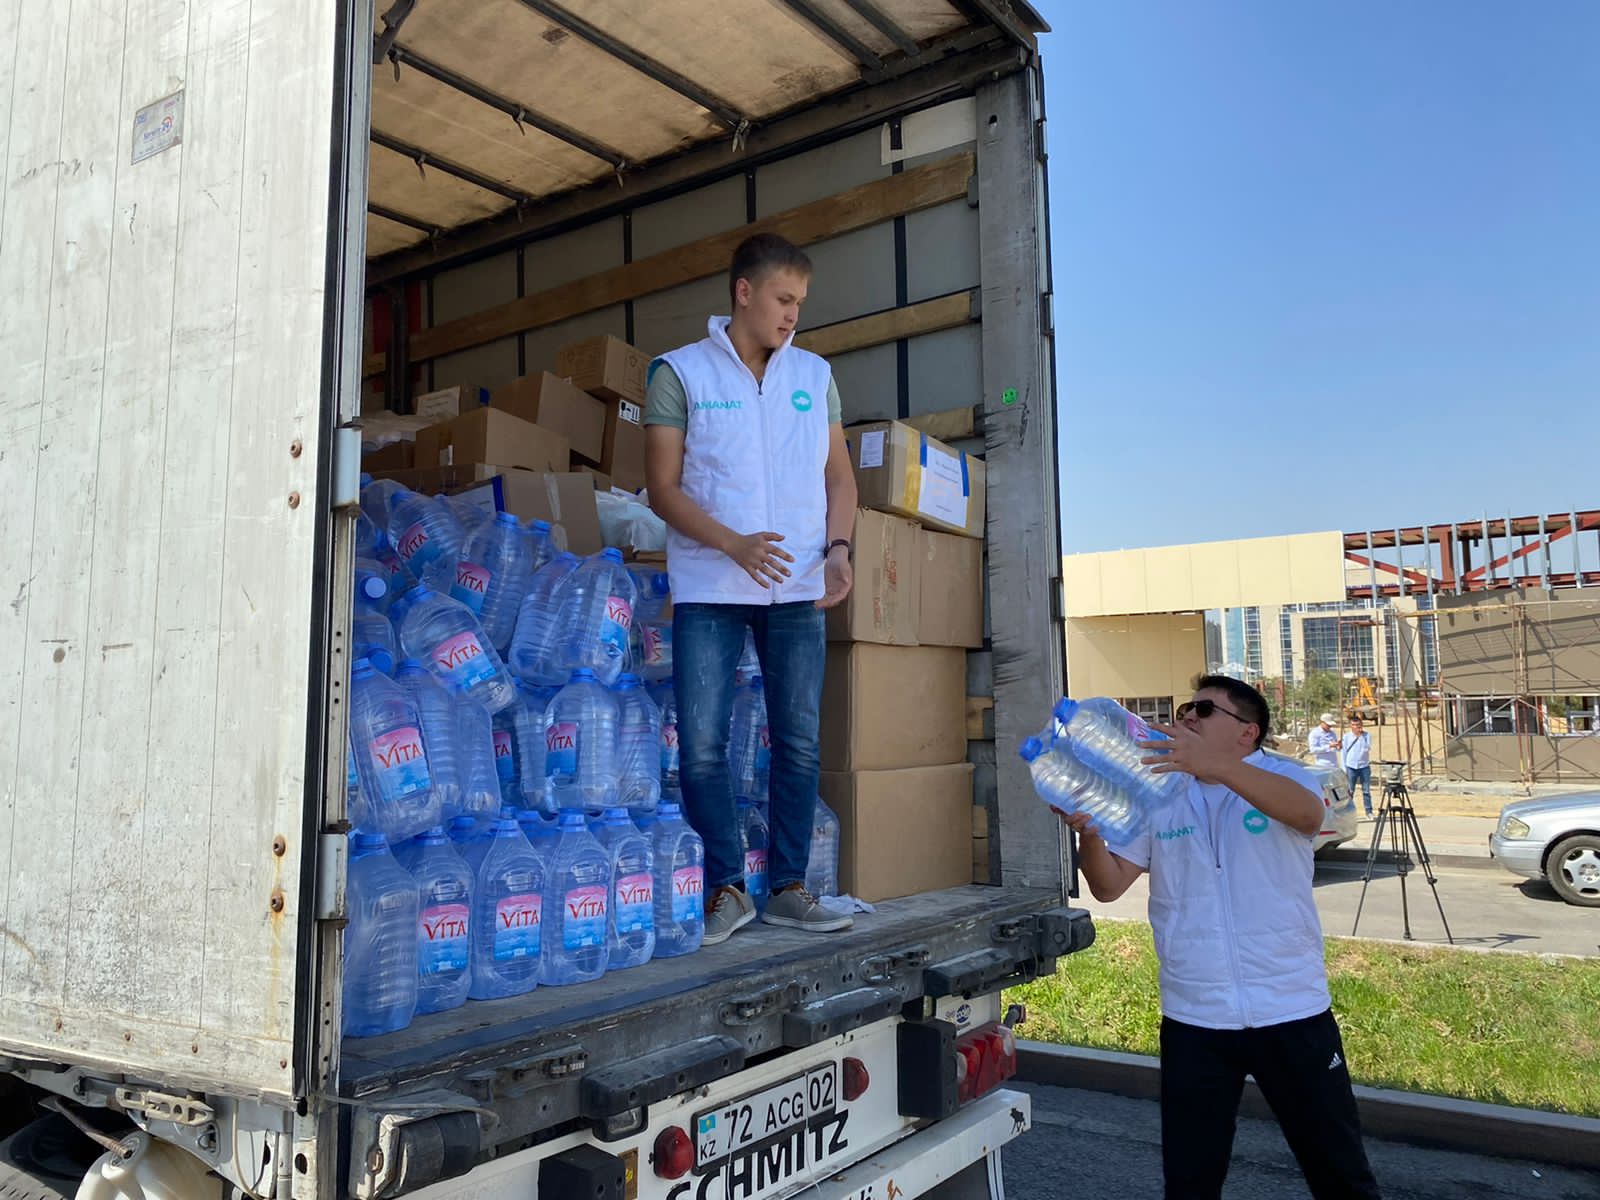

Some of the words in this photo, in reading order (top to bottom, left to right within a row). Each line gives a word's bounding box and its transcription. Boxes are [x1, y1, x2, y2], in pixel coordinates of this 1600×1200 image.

[694, 401, 742, 411] AMANAT
[402, 534, 428, 559] VITA
[456, 570, 484, 592] VITA
[439, 646, 481, 669] VITA
[546, 733, 574, 752] VITA
[376, 741, 423, 768] VITA
[620, 883, 652, 904] VITA
[500, 905, 539, 929] VITA
[568, 895, 605, 919] VITA
[423, 916, 467, 941] VITA
[724, 1104, 753, 1150] 72
[764, 1092, 804, 1133] ACG
[809, 1071, 834, 1111] 02
[700, 1140, 716, 1161] KZ
